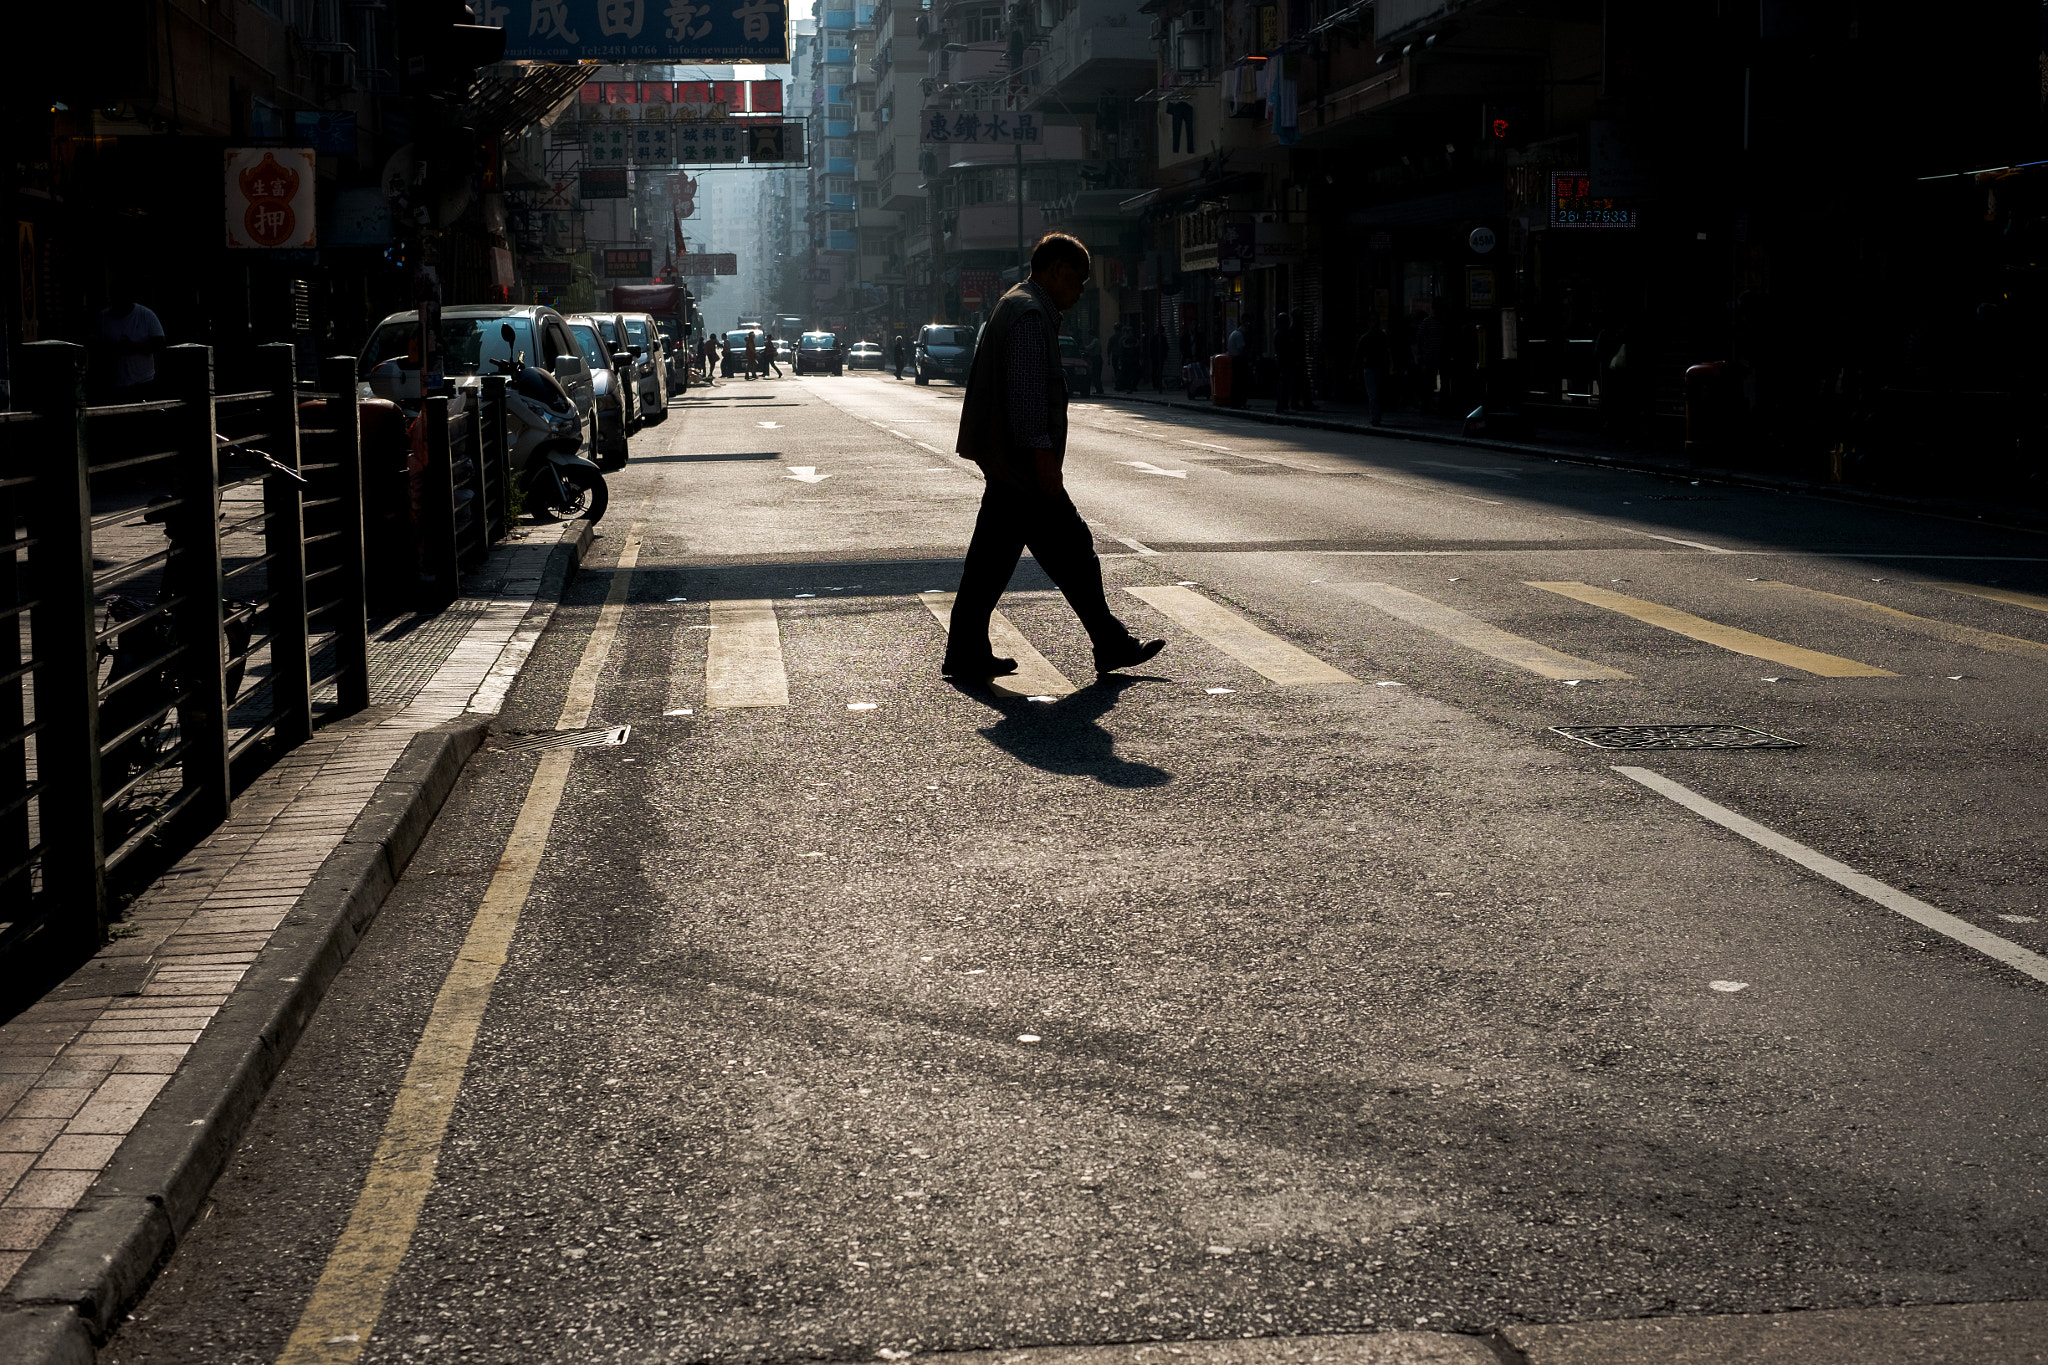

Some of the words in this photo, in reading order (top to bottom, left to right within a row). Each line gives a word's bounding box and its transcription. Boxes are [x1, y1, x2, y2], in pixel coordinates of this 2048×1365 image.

[630, 45, 659, 55] 0766
[926, 111, 1038, 142] 惠鑽水晶
[253, 205, 286, 238] 押
